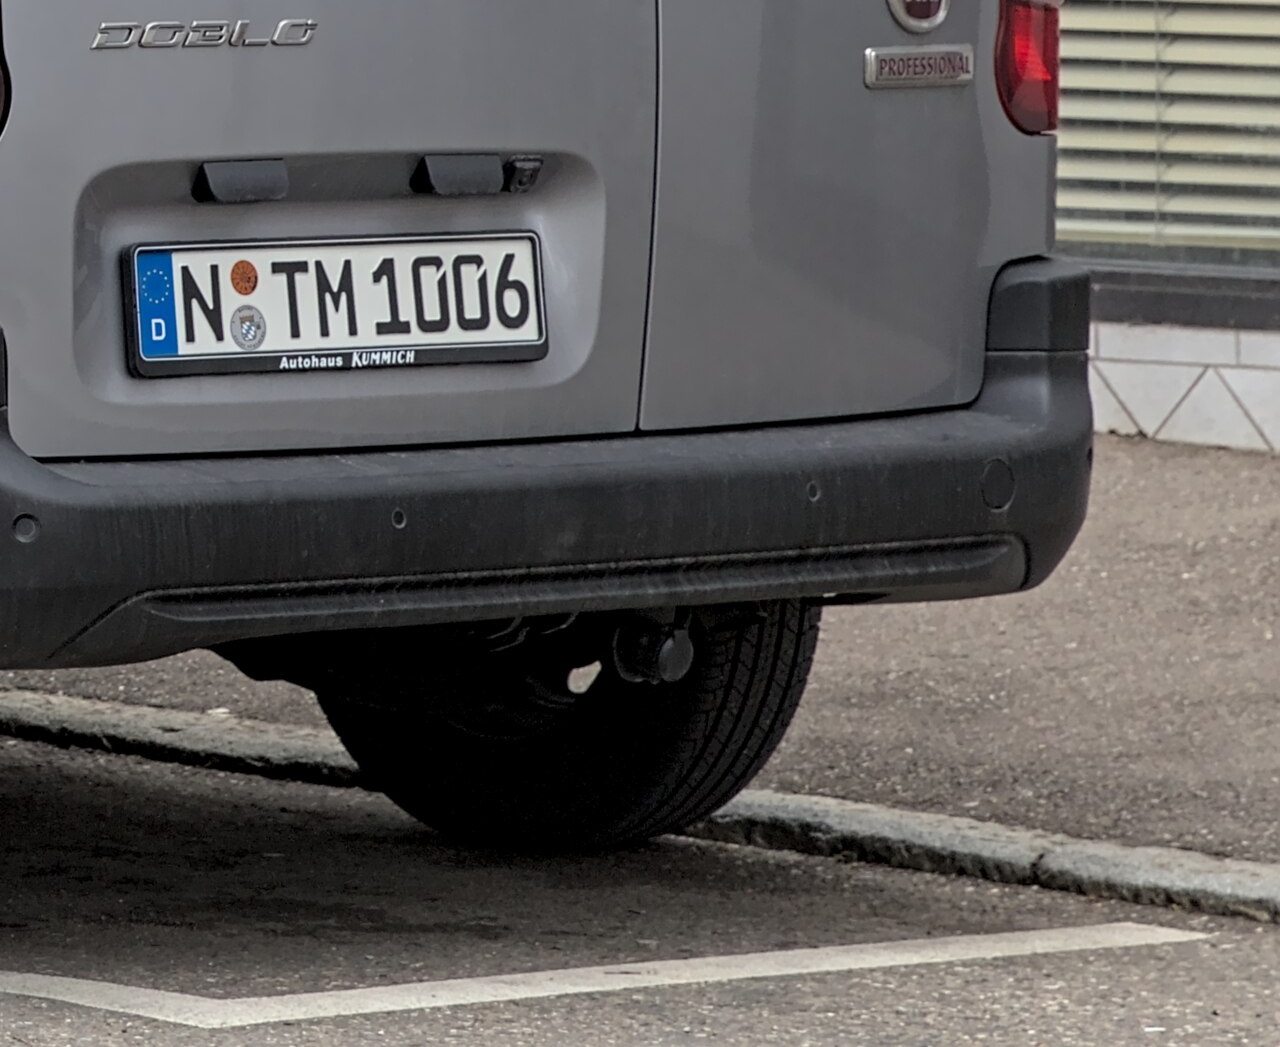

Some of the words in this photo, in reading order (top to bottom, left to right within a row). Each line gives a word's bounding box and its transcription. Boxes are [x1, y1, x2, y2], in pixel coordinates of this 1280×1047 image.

[880, 55, 971, 76] PROFESSIONAL
[180, 263, 225, 344] N
[151, 318, 166, 341] D
[279, 356, 343, 370] Autohaus
[351, 350, 416, 369] KUMMICH
